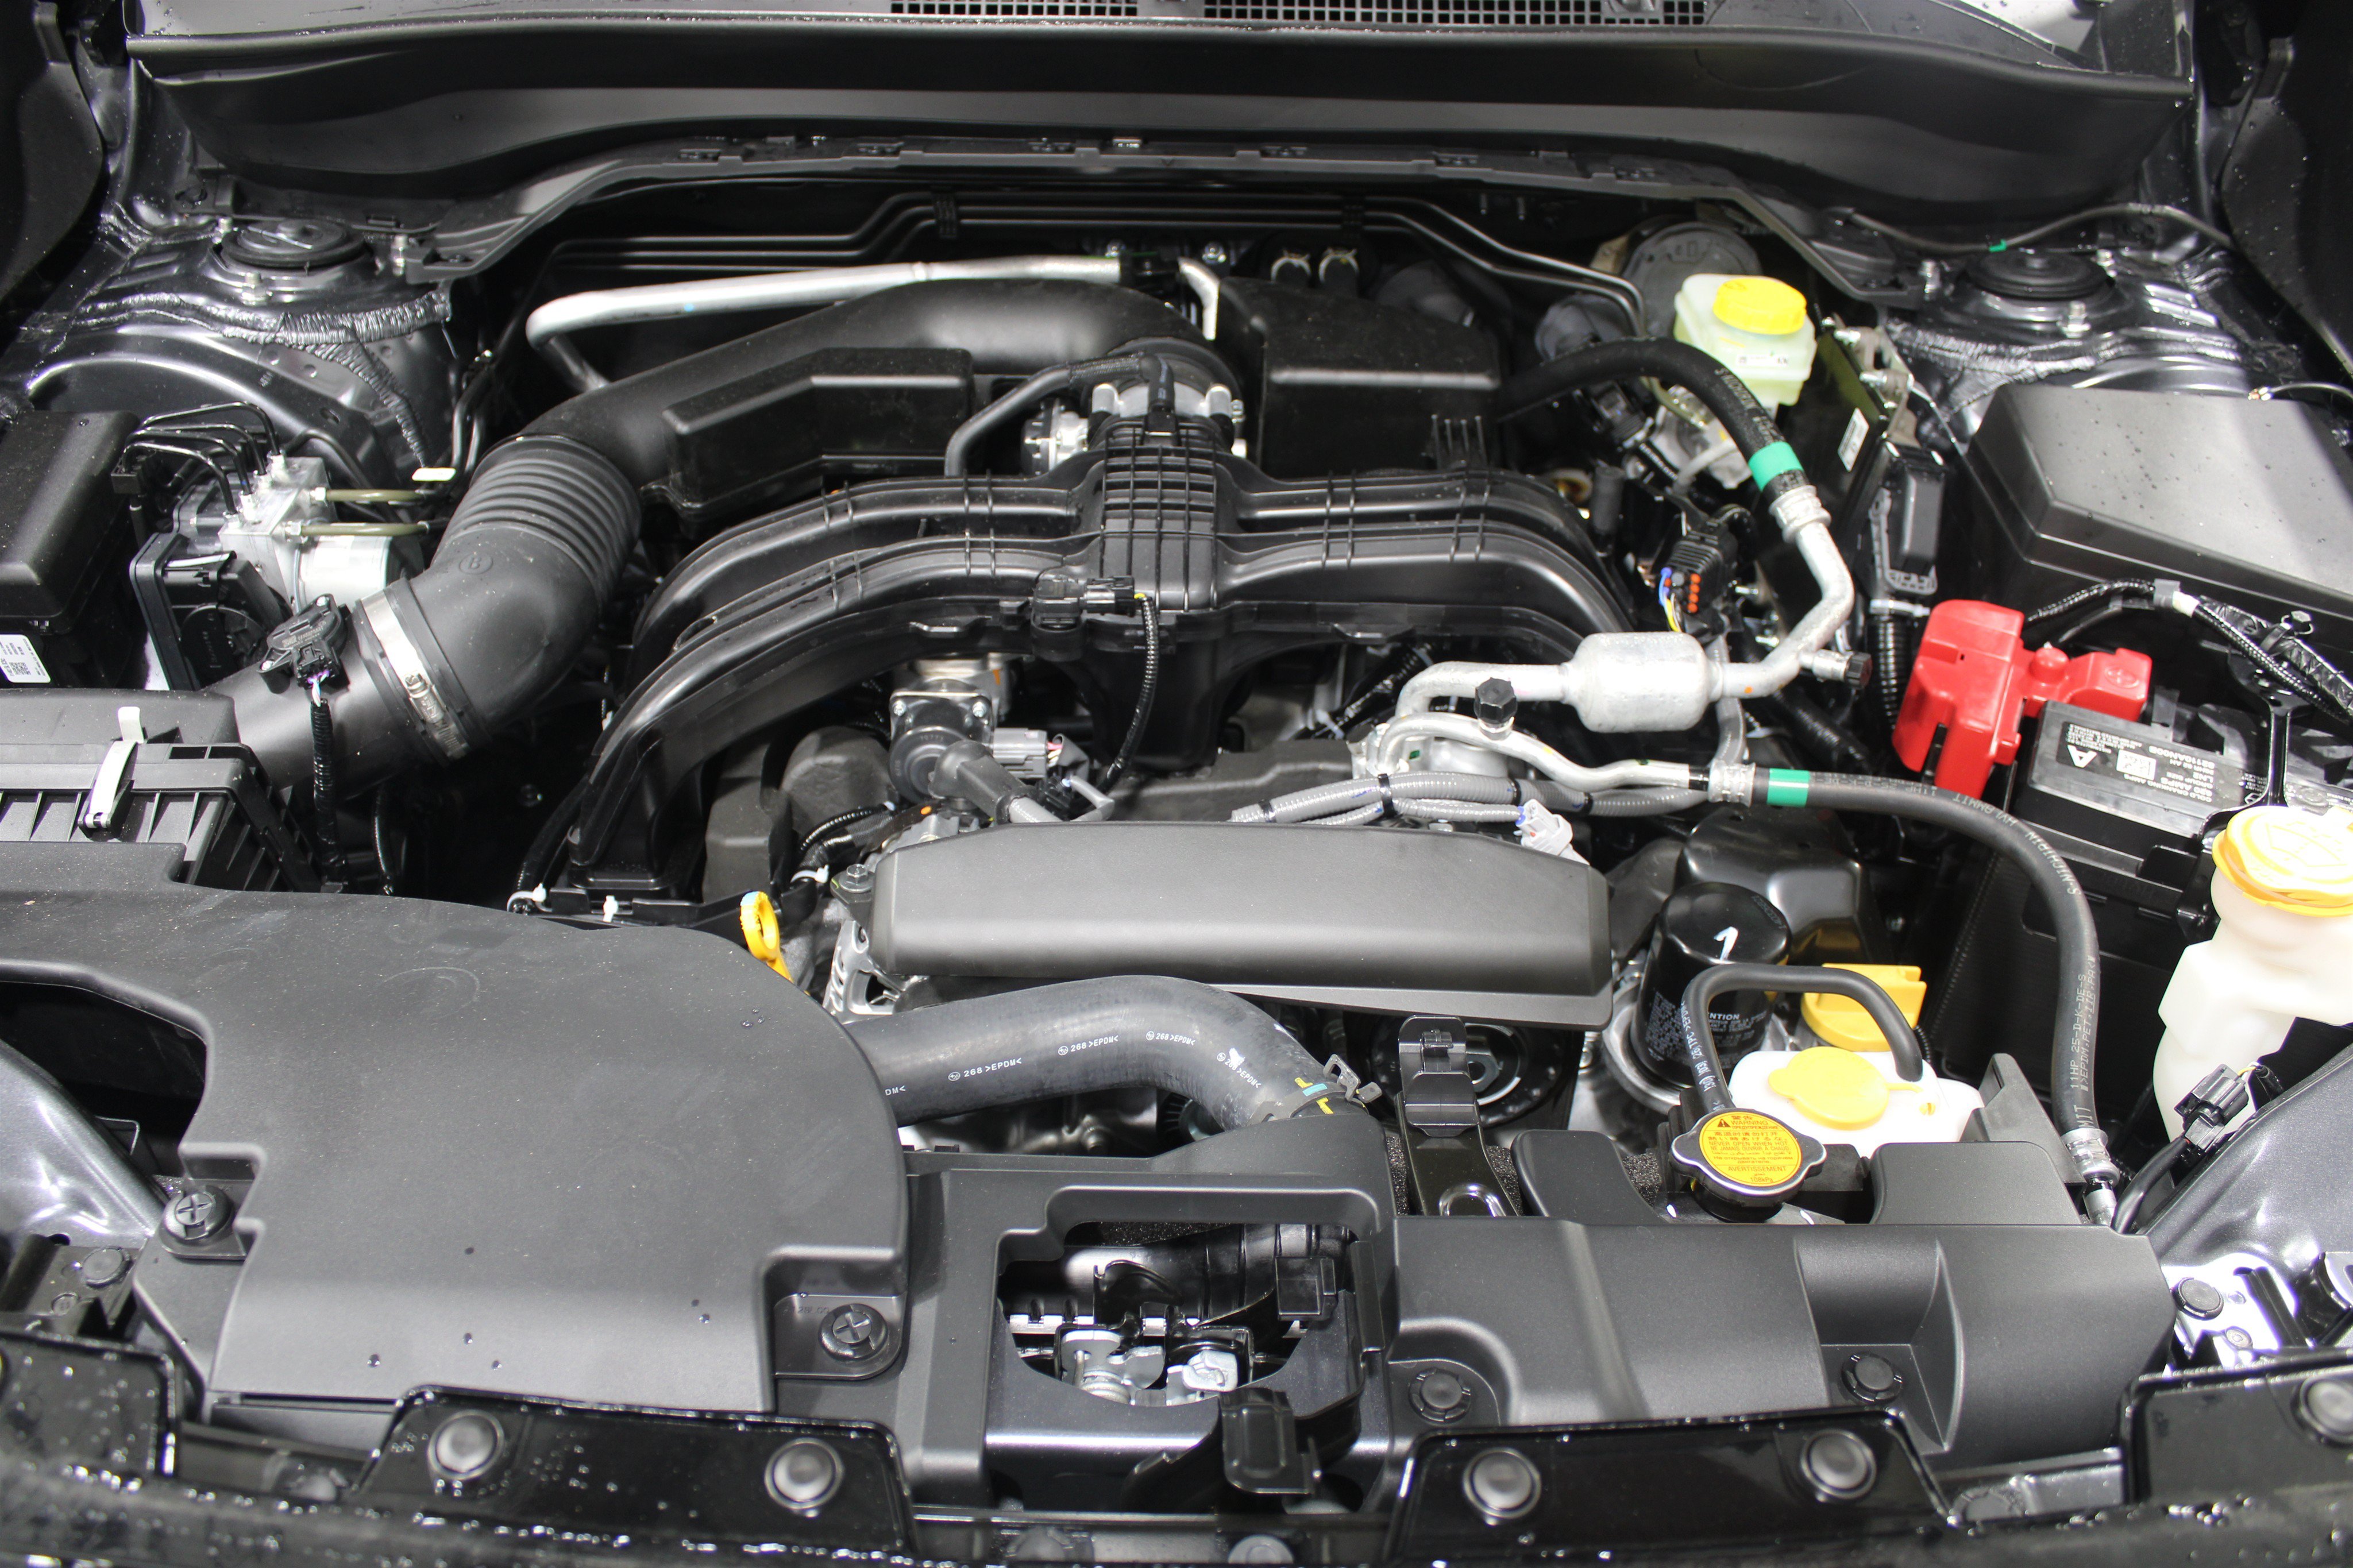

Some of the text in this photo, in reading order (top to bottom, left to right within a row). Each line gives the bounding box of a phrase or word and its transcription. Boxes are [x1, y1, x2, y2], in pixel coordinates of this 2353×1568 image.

[2067, 744, 2097, 768] A
[2147, 780, 2188, 795] CRANKING
[2161, 777, 2191, 790] AMPS
[2189, 792, 2212, 802] COLD
[1070, 1035, 1118, 1052] 268 >EPDM<
[1155, 1032, 1196, 1046] 268 >EPDM<
[963, 1057, 1022, 1077] 268 >EPDM<
[2068, 1059, 2080, 1088] 11HP
[1236, 1068, 1262, 1088] >EPDM<
